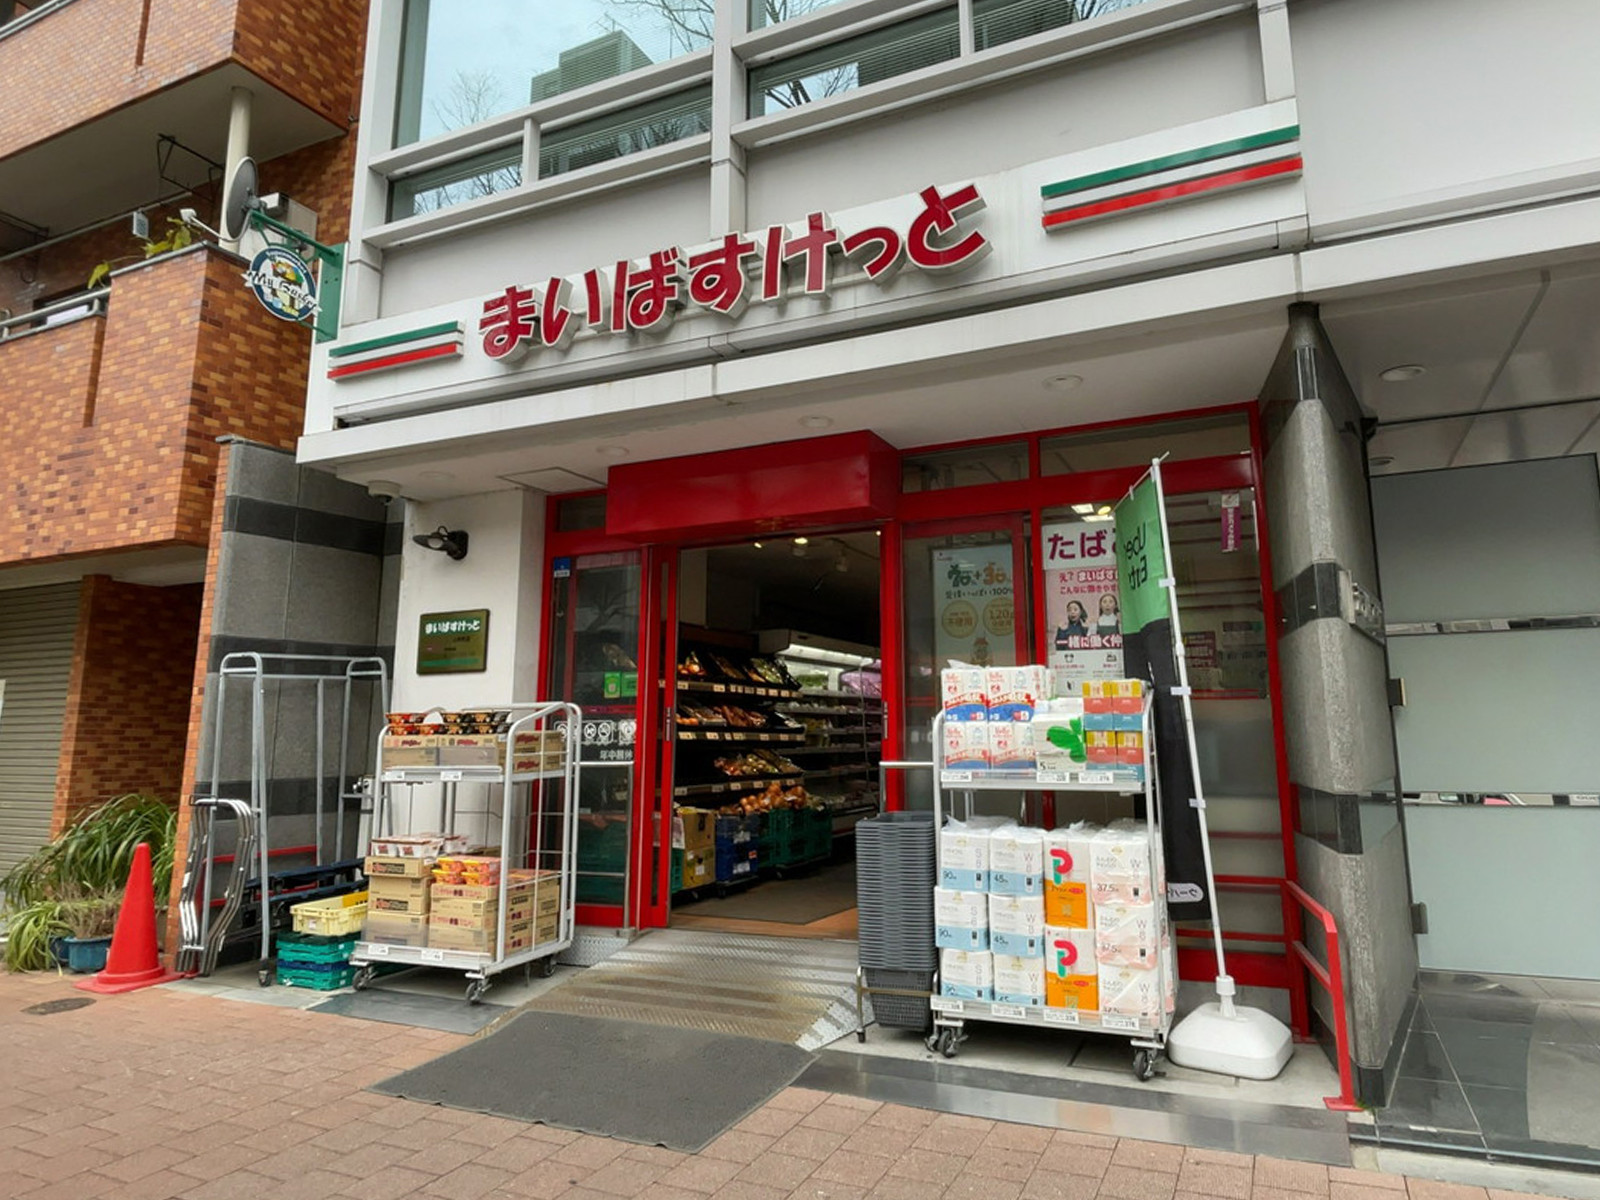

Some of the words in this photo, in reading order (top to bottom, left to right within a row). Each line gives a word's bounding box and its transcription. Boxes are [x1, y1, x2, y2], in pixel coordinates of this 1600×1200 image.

[479, 184, 988, 361] まいばすけっと
